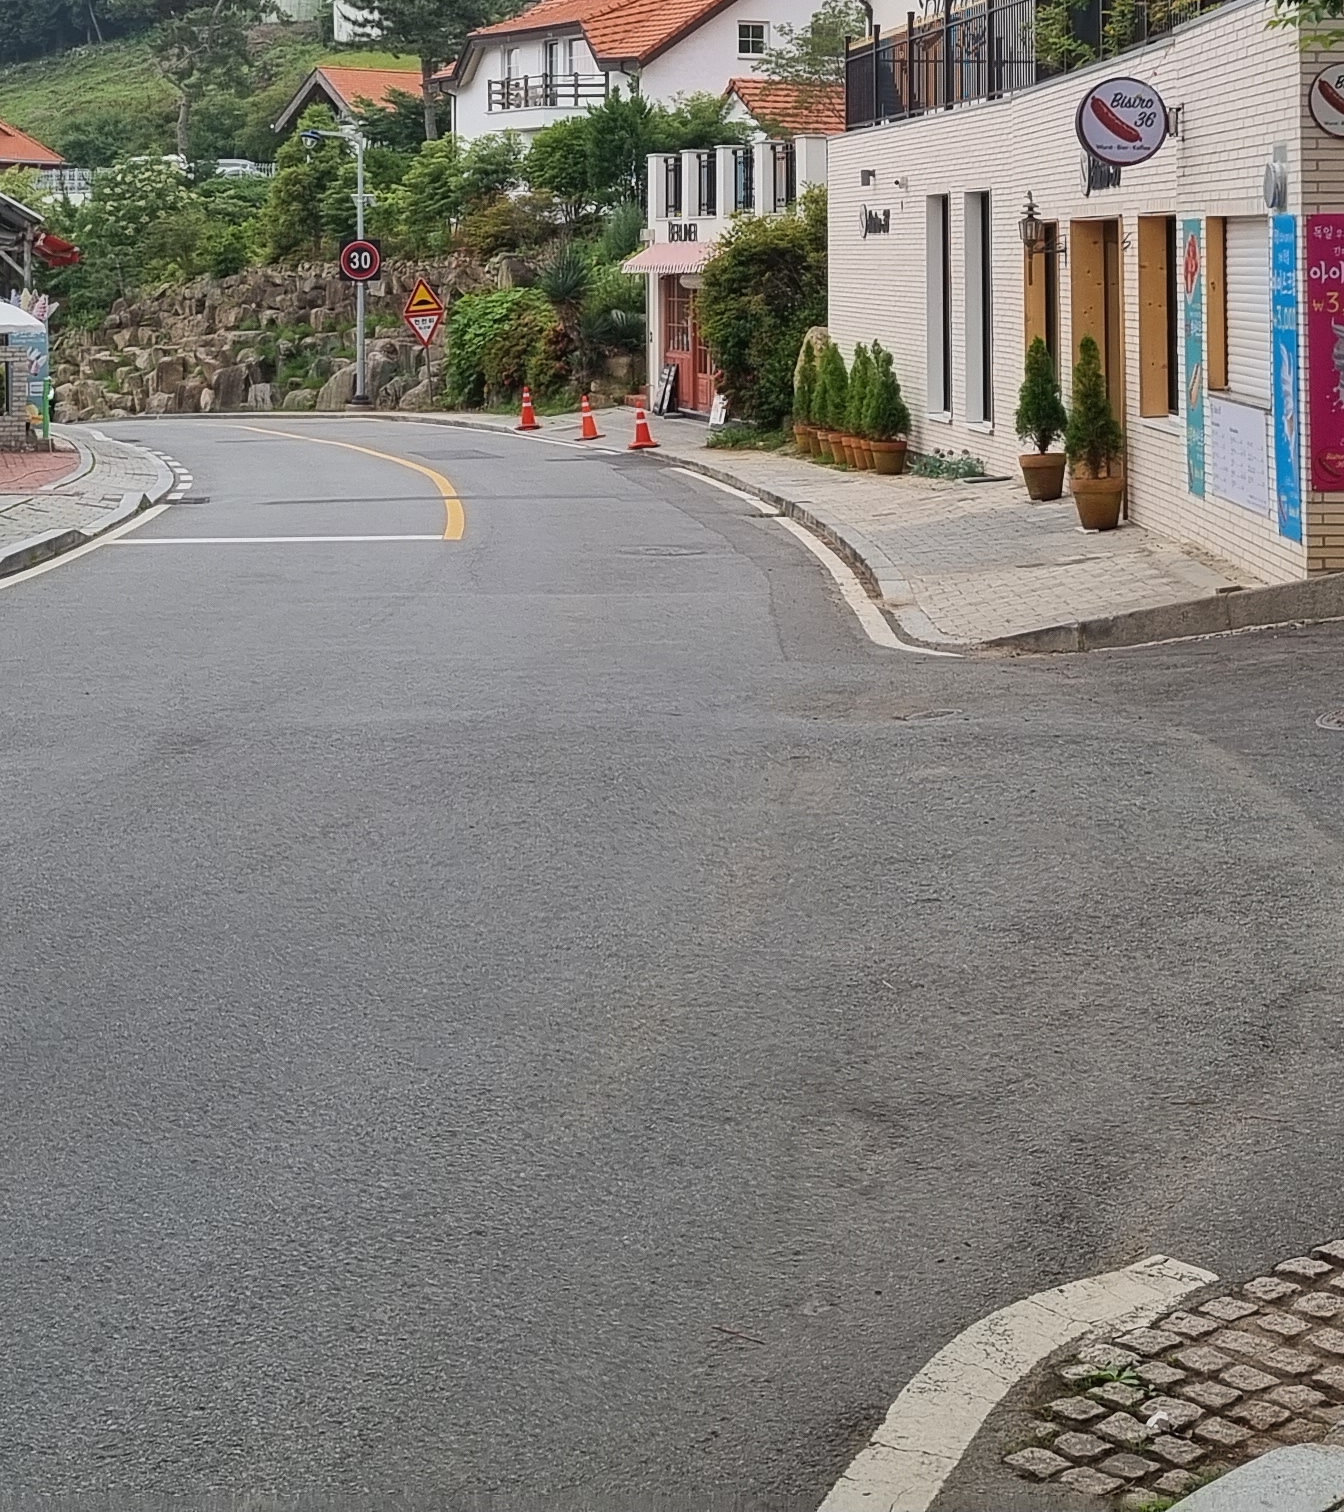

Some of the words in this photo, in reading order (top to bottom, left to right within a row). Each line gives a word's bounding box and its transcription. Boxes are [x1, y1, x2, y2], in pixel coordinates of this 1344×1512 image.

[1110, 92, 1154, 109] Bistro
[1134, 111, 1157, 128] 36
[1313, 225, 1333, 240] 독일
[350, 252, 370, 268] 30
